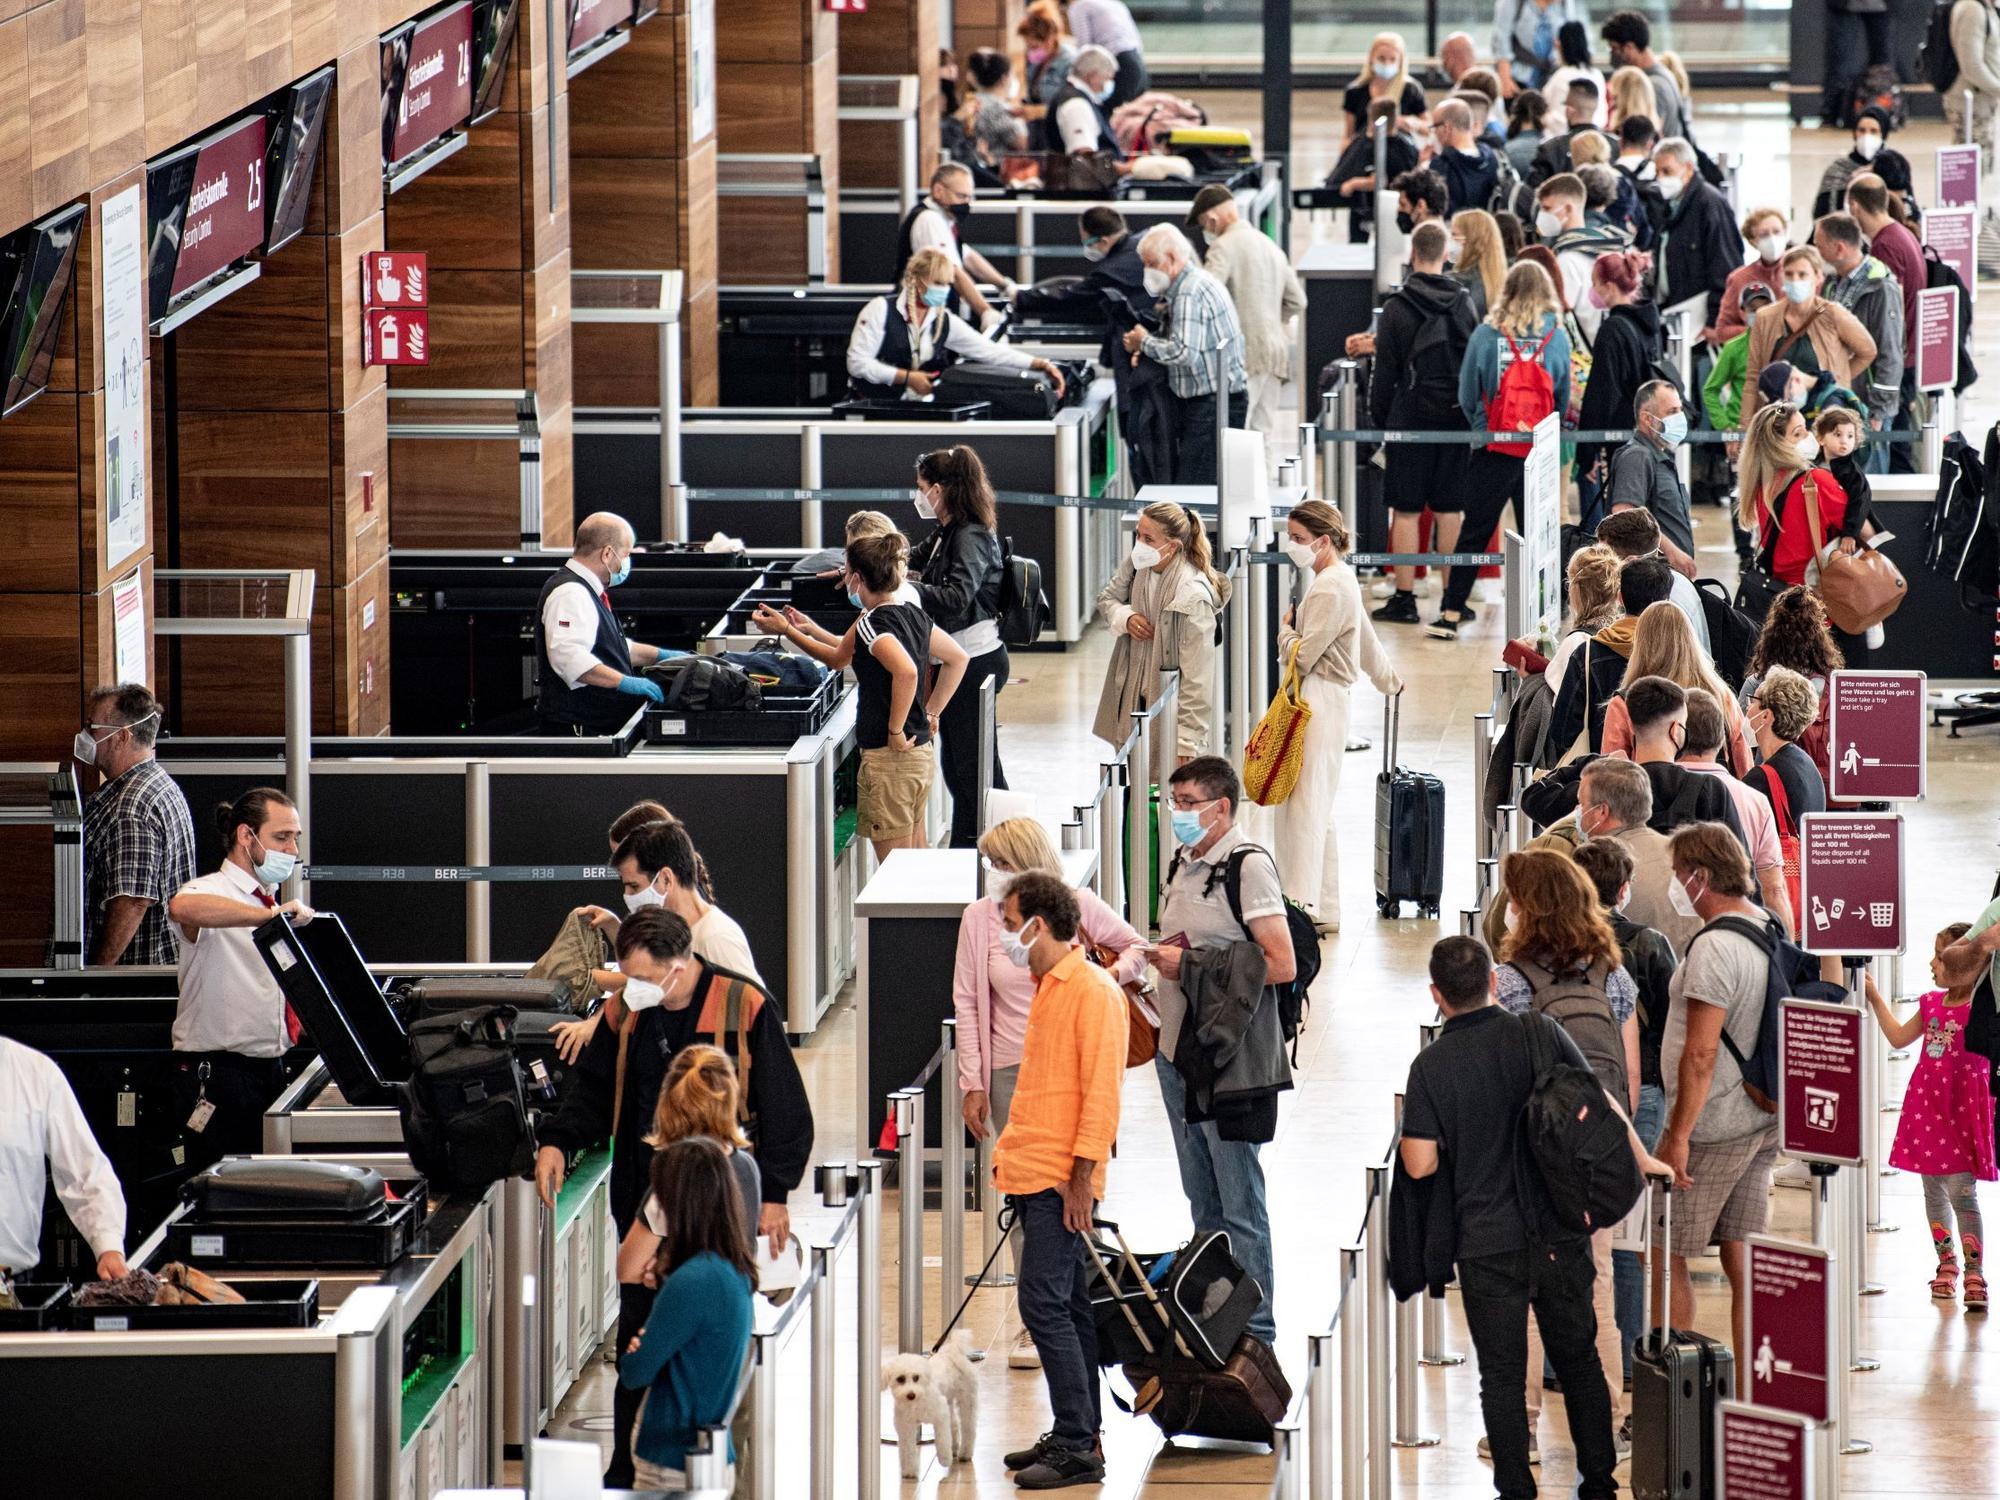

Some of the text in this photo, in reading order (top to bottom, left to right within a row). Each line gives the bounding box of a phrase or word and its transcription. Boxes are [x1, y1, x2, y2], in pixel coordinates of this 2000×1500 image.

[248, 158, 261, 212] 2.5
[794, 490, 812, 499] BER
[1064, 497, 1080, 506] BER
[1352, 555, 1371, 564] BER
[1471, 555, 1490, 564] BER
[434, 869, 458, 879] BER
[583, 867, 606, 878] BER
